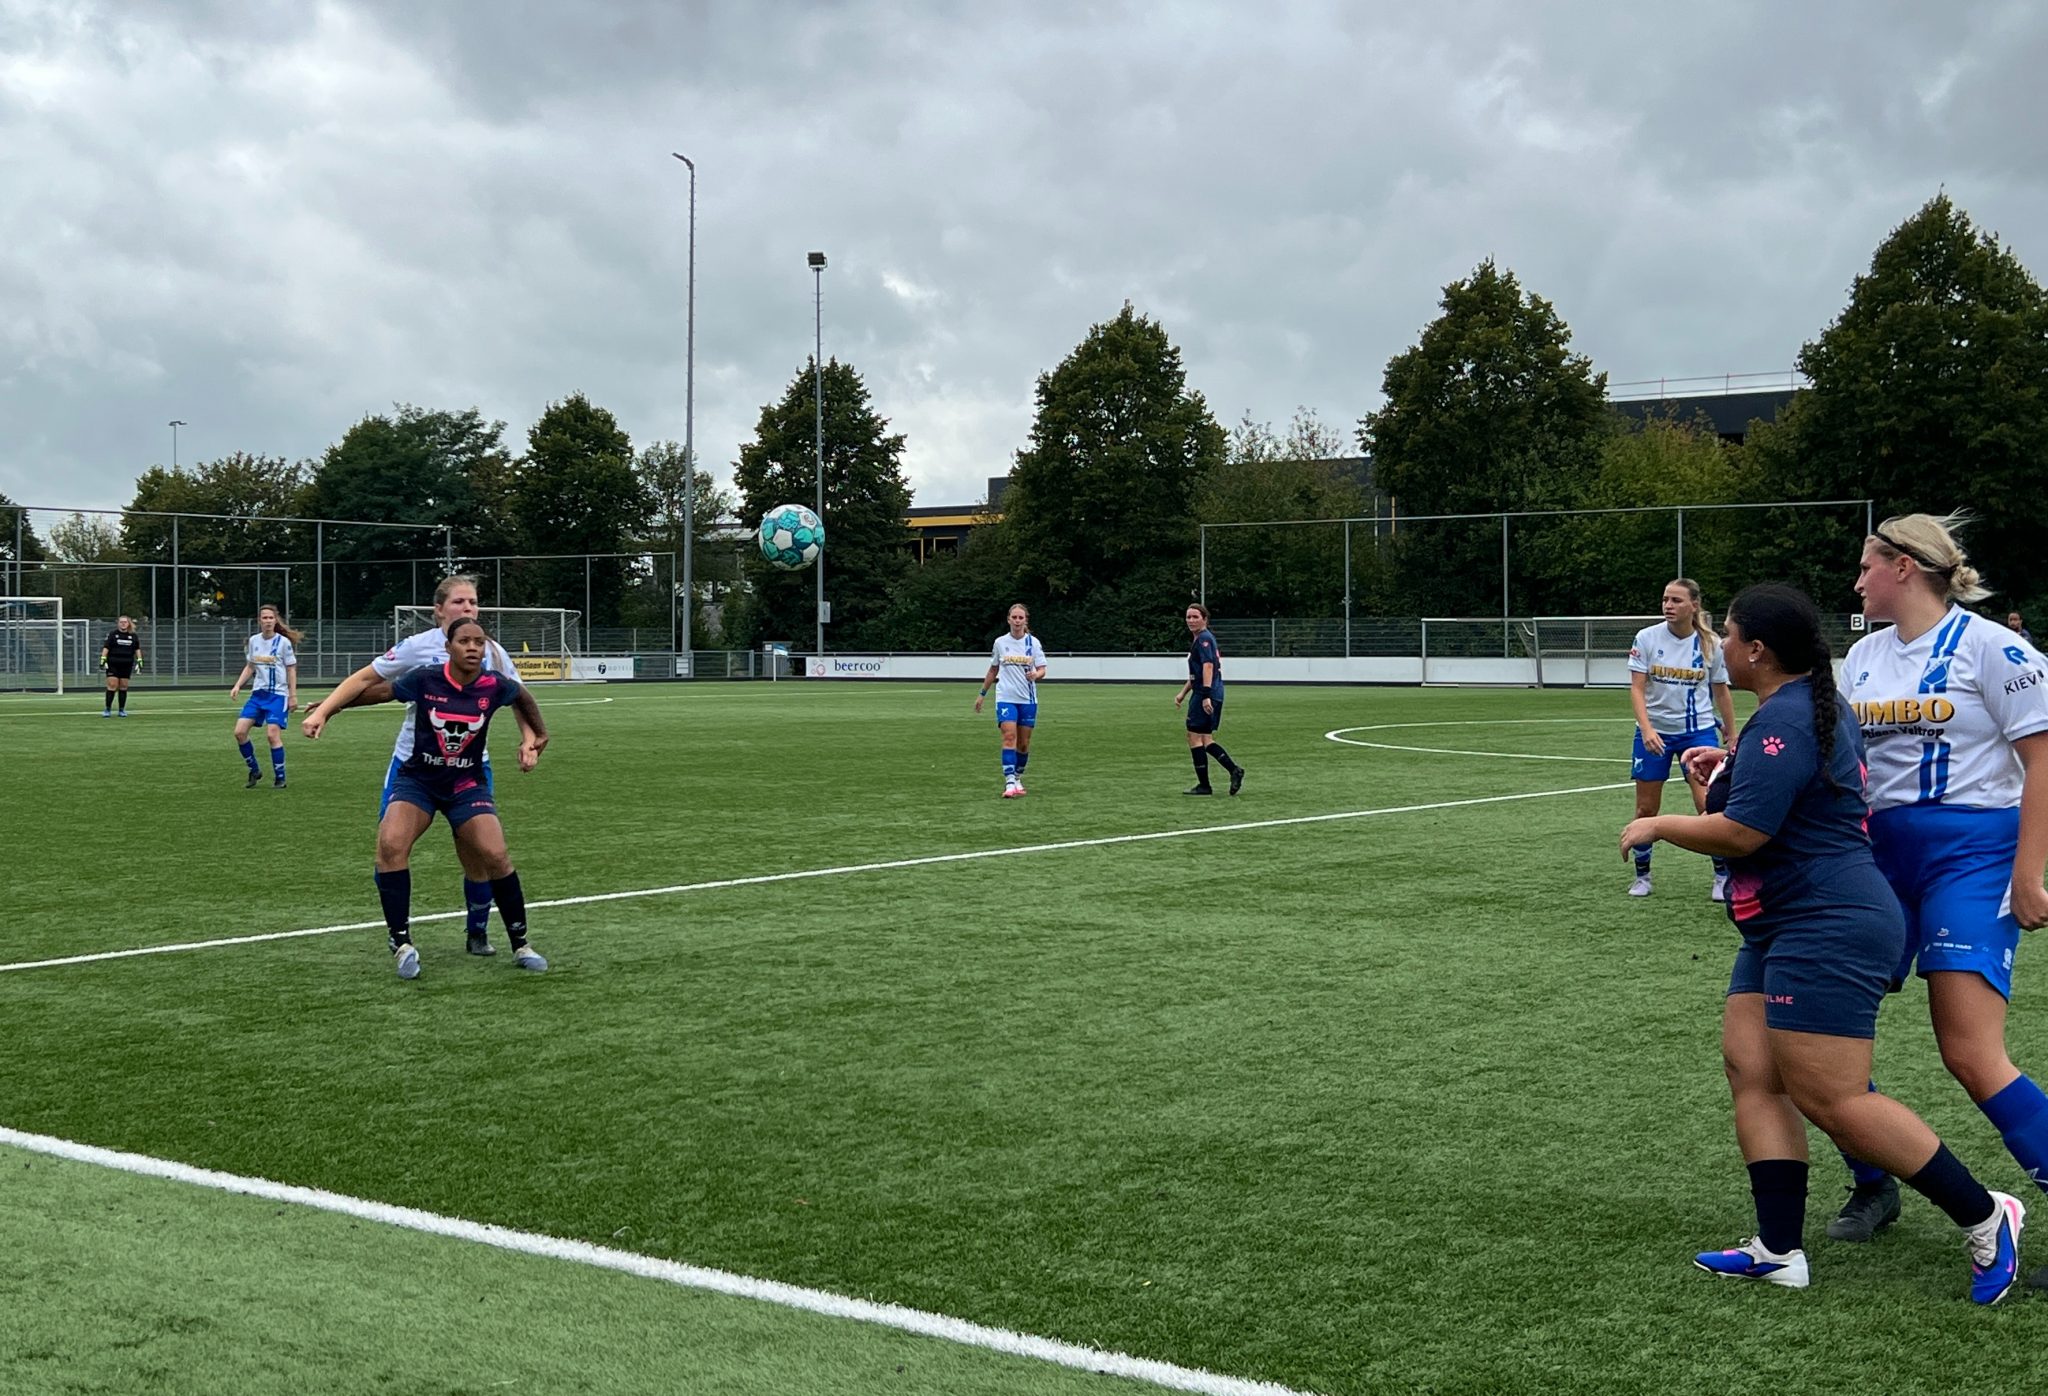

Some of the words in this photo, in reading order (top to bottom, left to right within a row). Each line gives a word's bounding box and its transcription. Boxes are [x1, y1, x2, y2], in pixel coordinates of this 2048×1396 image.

[1853, 617, 1862, 627] B
[513, 659, 542, 668] hristiaan
[543, 660, 568, 669] Veltrp
[834, 659, 881, 671] beercoo
[1651, 665, 1706, 681] JUMBO
[1851, 698, 1955, 727] UMBO
[422, 752, 445, 766] THE
[447, 757, 475, 768] BULL
[1766, 995, 1793, 1004] LME
